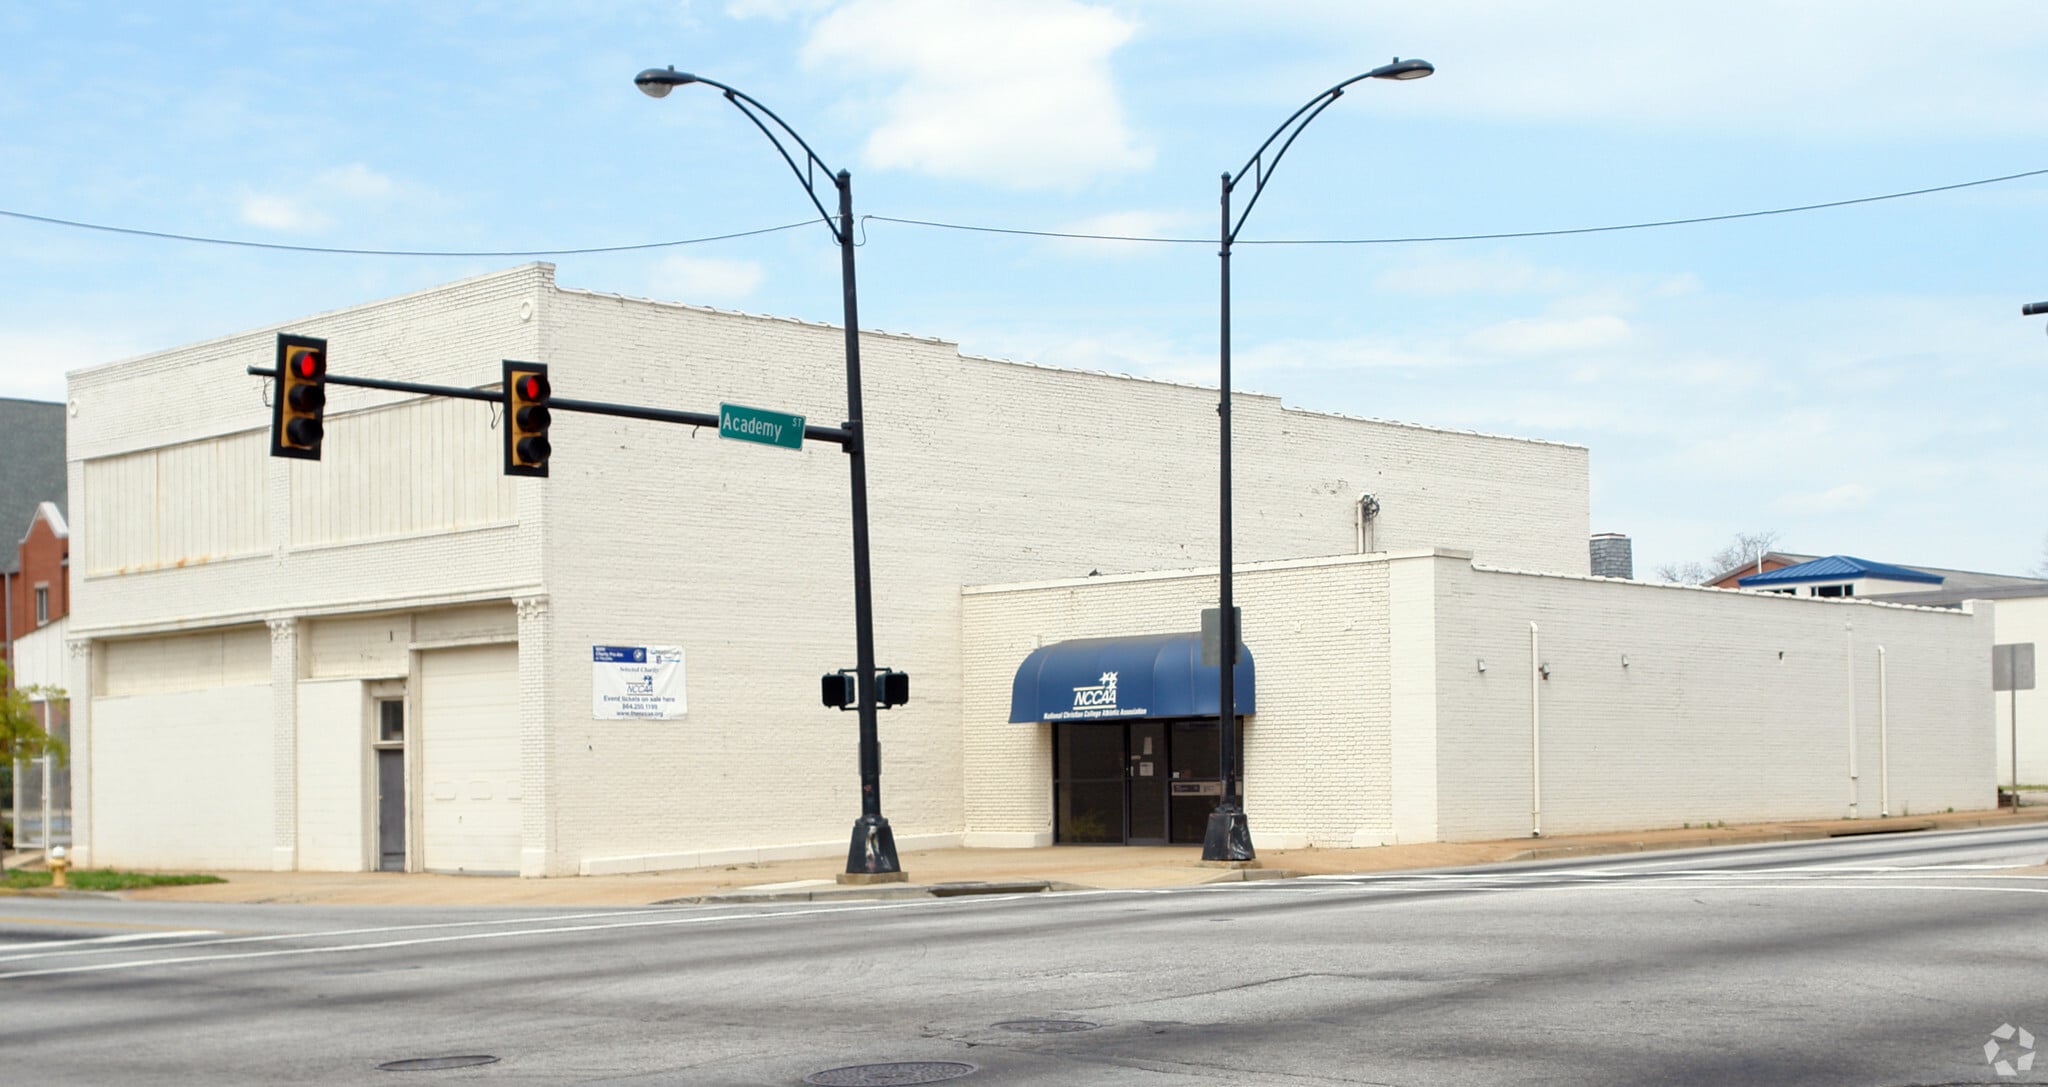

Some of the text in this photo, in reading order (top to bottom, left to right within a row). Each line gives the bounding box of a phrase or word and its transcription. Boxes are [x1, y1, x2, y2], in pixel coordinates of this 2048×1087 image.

[723, 412, 802, 442] Academy ST
[1074, 690, 1116, 705] NCCAA
[1043, 708, 1147, 720] National Christian College Athletic Association
